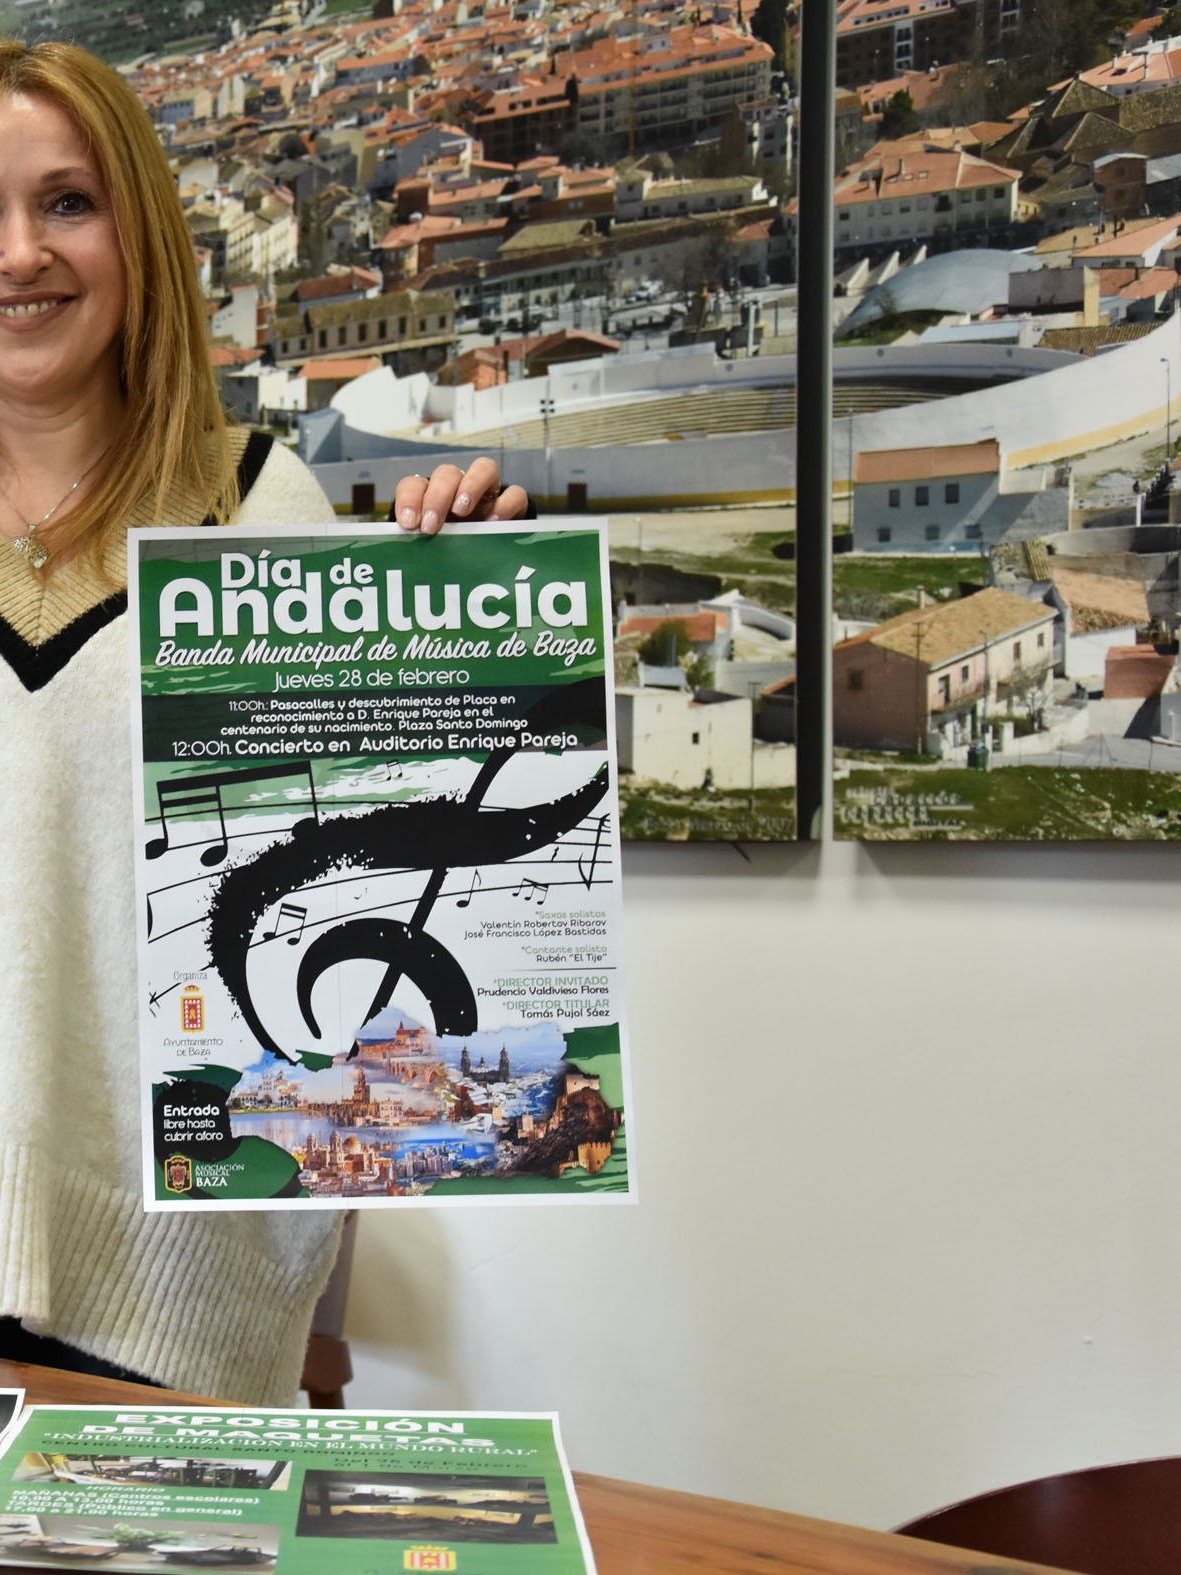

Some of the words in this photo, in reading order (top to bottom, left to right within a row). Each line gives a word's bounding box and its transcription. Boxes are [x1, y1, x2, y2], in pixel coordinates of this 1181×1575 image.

[220, 549, 302, 588] Día
[329, 557, 374, 585] de
[159, 565, 588, 638] Andalucía
[155, 640, 235, 667] Banda
[239, 634, 363, 670] Municipal
[368, 635, 398, 661] de
[402, 632, 492, 660] Música
[497, 630, 527, 657] de
[532, 630, 597, 666] Baza
[272, 671, 335, 693] Jueves
[338, 669, 363, 688] 28
[366, 669, 393, 687] de
[398, 667, 470, 686] febrero
[270, 699, 335, 711] Pasacalles
[337, 700, 346, 711] y
[348, 696, 442, 709] descubrimiento
[444, 695, 461, 706] de
[463, 694, 498, 706] Placa
[500, 696, 516, 705] en
[250, 710, 344, 723] reconocimiento
[346, 712, 355, 721] a
[357, 710, 370, 720] D.
[373, 708, 420, 721] Enrique
[422, 708, 461, 721] Pareja
[464, 708, 479, 717] en
[482, 706, 494, 717] el
[220, 724, 288, 736] centenario
[290, 723, 306, 734] de
[308, 725, 322, 734] su
[398, 720, 434, 732] Plaza
[436, 718, 473, 730] Santo
[475, 718, 528, 731] Domingo
[172, 740, 232, 757] 12:00h.
[234, 738, 324, 755] Concierto
[328, 740, 351, 752] en
[359, 735, 444, 752] Auditorio
[448, 733, 517, 752] Enrique
[521, 731, 578, 749] Pareja
[569, 910, 606, 918] solistas
[480, 920, 521, 929] Valentín
[524, 919, 568, 928] Robertov
[570, 919, 607, 927] Ribarov
[464, 930, 484, 940] José
[486, 929, 531, 938] Francisco
[533, 928, 562, 939] López
[565, 928, 607, 936] Bastidas
[575, 945, 607, 953] solista
[536, 954, 566, 962] Rubén
[173, 970, 208, 982] Organiza
[555, 976, 609, 985] INVITADO
[477, 987, 527, 996] Prudencio
[529, 986, 578, 996] Valdivieso
[581, 985, 609, 994] Flores
[564, 999, 610, 1009] TITULAR
[521, 1009, 553, 1018] Tomás
[557, 1008, 583, 1019] Pujol
[586, 1007, 610, 1017] Sáez
[163, 1104, 220, 1117] Entrada
[164, 1119, 186, 1130] libre
[187, 1119, 215, 1129] hasta
[164, 1131, 194, 1142] cubrir
[196, 1131, 223, 1141] aforo
[195, 1163, 244, 1171] ASOCIACIÓN
[196, 1177, 228, 1187] BAZA
[115, 1414, 465, 1434] EXPOSICIÓN
[82, 1425, 156, 1434] DE
[175, 1428, 496, 1447] MAQUETAS
[360, 1443, 444, 1452] MUNDO
[173, 1507, 242, 1516] general)
